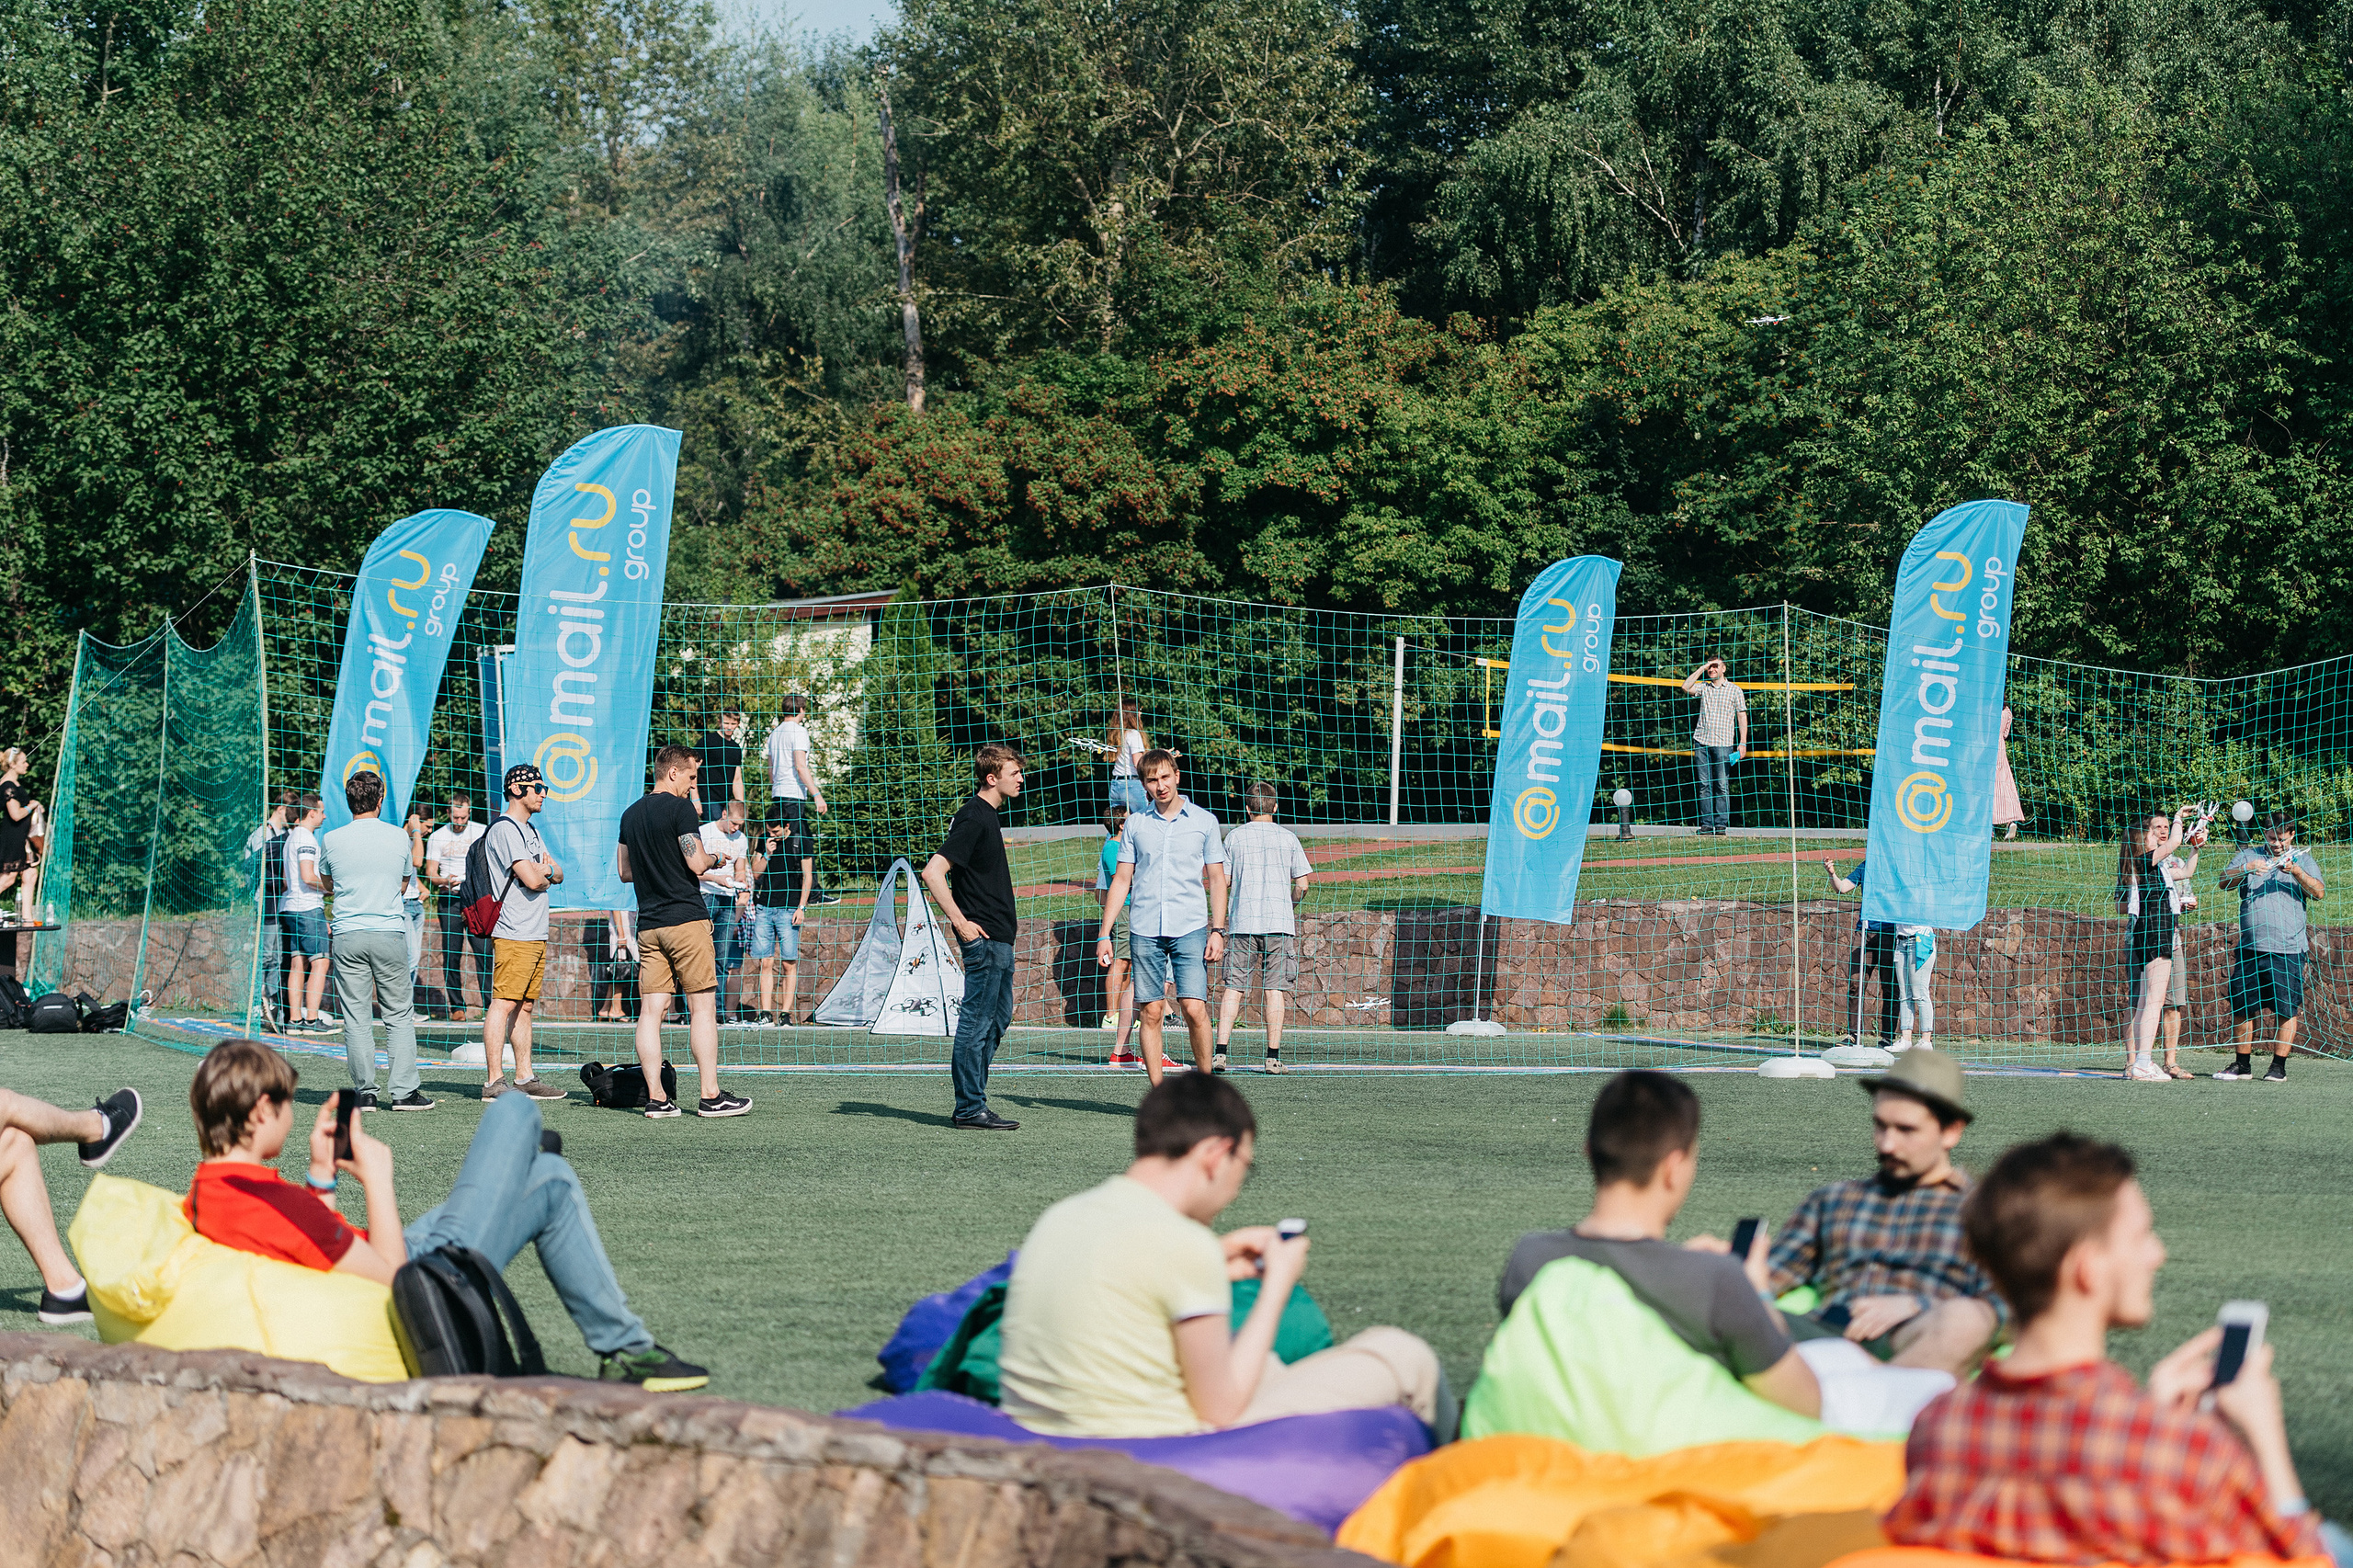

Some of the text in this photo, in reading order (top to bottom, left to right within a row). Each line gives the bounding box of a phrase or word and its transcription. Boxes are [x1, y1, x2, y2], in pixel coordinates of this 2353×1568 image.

[625, 489, 656, 579] group
[426, 563, 460, 637] group
[534, 483, 617, 801] @mail.ru
[1583, 603, 1601, 673] group
[1978, 557, 2007, 638] group
[1514, 599, 1576, 839] @mail.ru
[1896, 552, 1972, 832] @mail.ru
